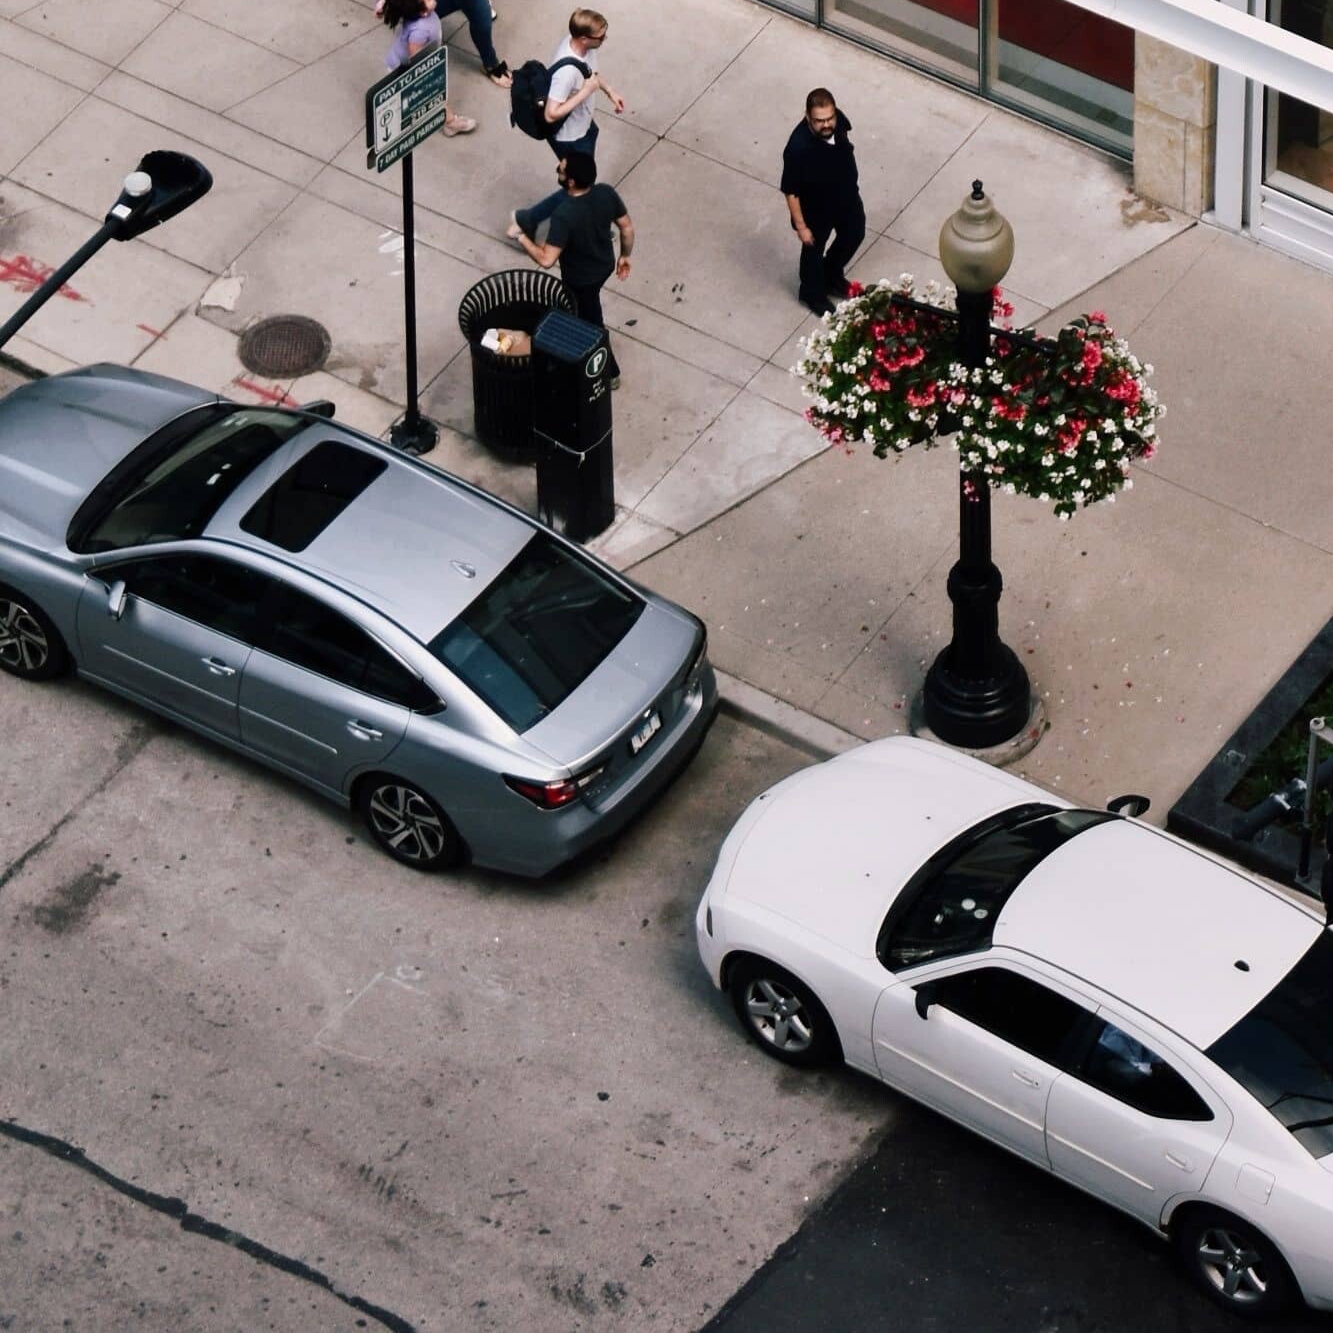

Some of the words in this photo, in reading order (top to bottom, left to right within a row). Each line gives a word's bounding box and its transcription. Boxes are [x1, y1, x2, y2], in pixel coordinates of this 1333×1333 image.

[379, 83, 397, 103] PAY
[399, 73, 412, 88] TO
[415, 54, 440, 77] PARK
[386, 148, 398, 163] DAY
[400, 135, 416, 152] PAID
[417, 112, 445, 140] PARKING
[593, 352, 602, 373] P
